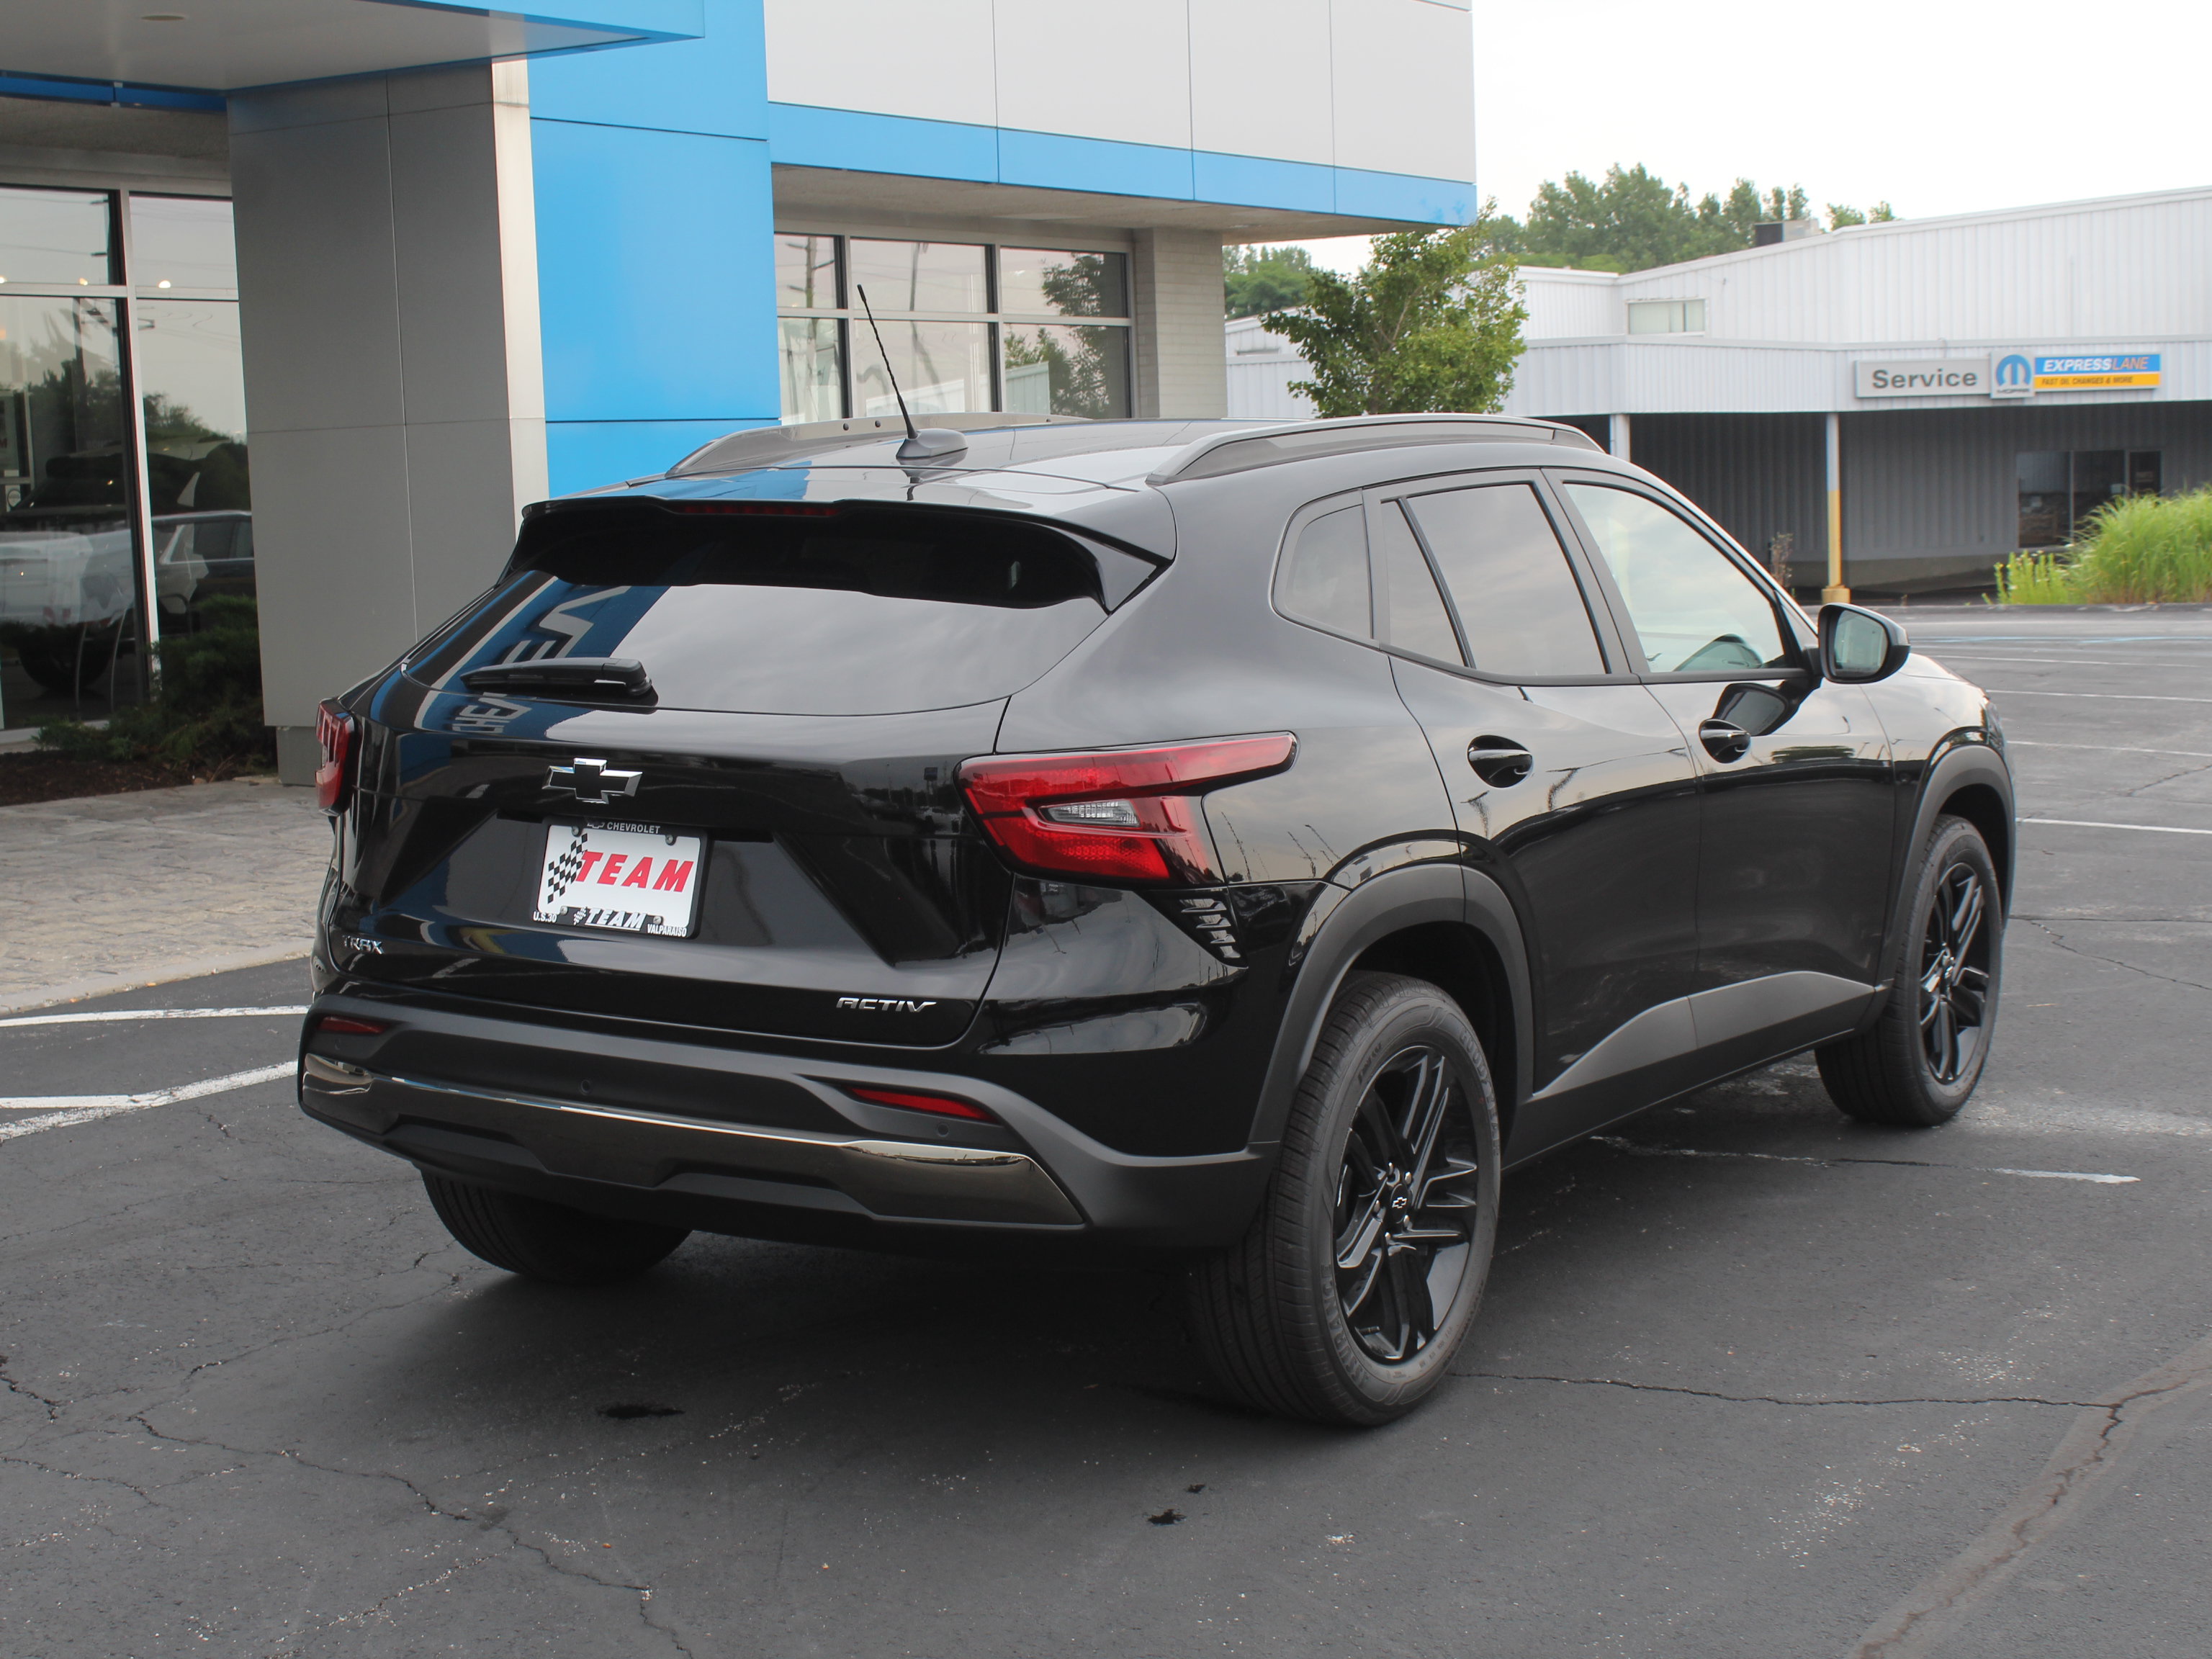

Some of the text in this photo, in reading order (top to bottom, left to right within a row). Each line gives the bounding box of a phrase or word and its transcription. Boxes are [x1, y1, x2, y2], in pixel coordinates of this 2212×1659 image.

[1872, 368, 1977, 389] Service
[606, 822, 660, 834] CHEVROLET
[576, 851, 694, 892] TEAM
[585, 907, 647, 929] TEAM
[647, 924, 687, 937] VALPARAISO
[836, 997, 937, 1012] ACTIV
